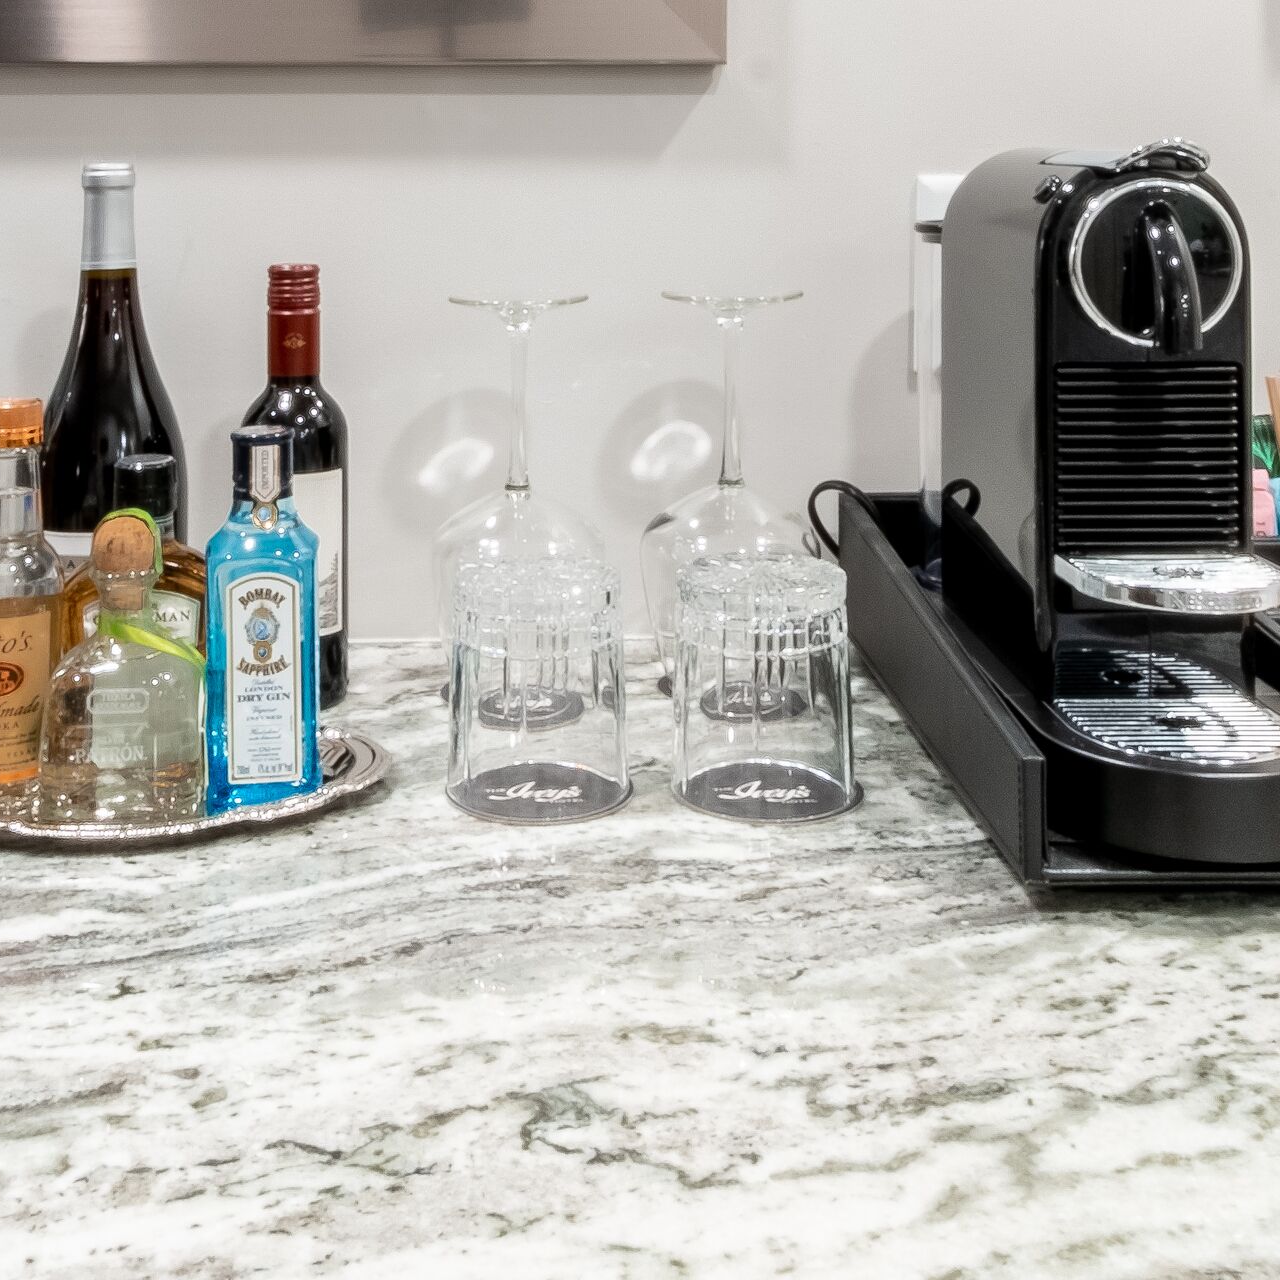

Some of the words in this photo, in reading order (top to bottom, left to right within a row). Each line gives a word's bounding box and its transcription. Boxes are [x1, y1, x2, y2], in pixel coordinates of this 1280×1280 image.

[238, 587, 287, 611] BOMBAY
[154, 609, 192, 624] MAN
[237, 653, 292, 677] SAPPHIRE
[236, 693, 265, 704] DRY
[266, 691, 292, 702] GIN
